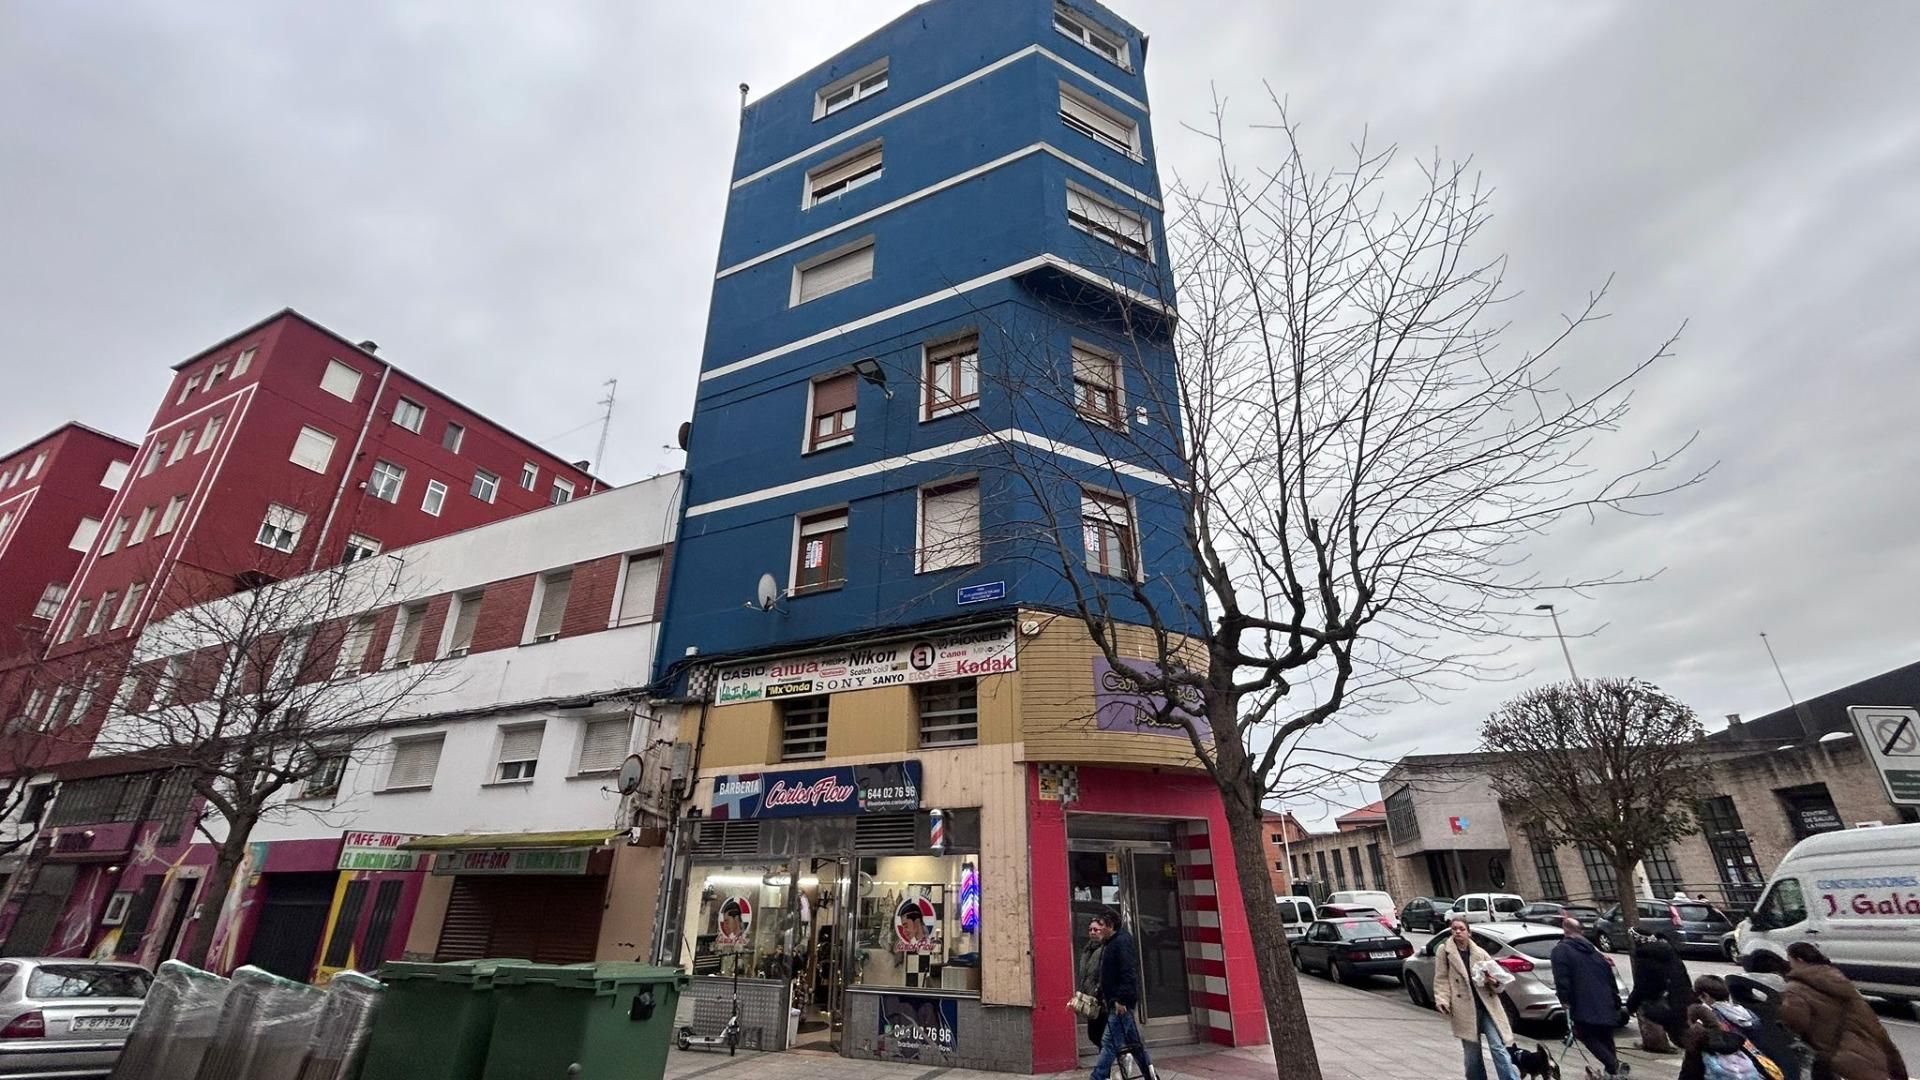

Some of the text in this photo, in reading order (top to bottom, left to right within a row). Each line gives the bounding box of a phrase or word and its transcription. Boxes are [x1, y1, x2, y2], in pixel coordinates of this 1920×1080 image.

[950, 632, 1008, 647] PIONEER
[849, 649, 897, 667] Nikon
[940, 650, 967, 658] Canon
[770, 662, 818, 678] aiwa
[850, 668, 872, 676] Scotch
[957, 655, 1013, 674] Kodak
[721, 667, 766, 681] CASIO
[872, 673, 905, 685] SANYO
[815, 676, 866, 691] SONY
[868, 788, 882, 799] 644
[883, 787, 894, 798] 02
[894, 786, 904, 797] 76
[926, 1027, 937, 1041] 76
[939, 1028, 951, 1043] 96
